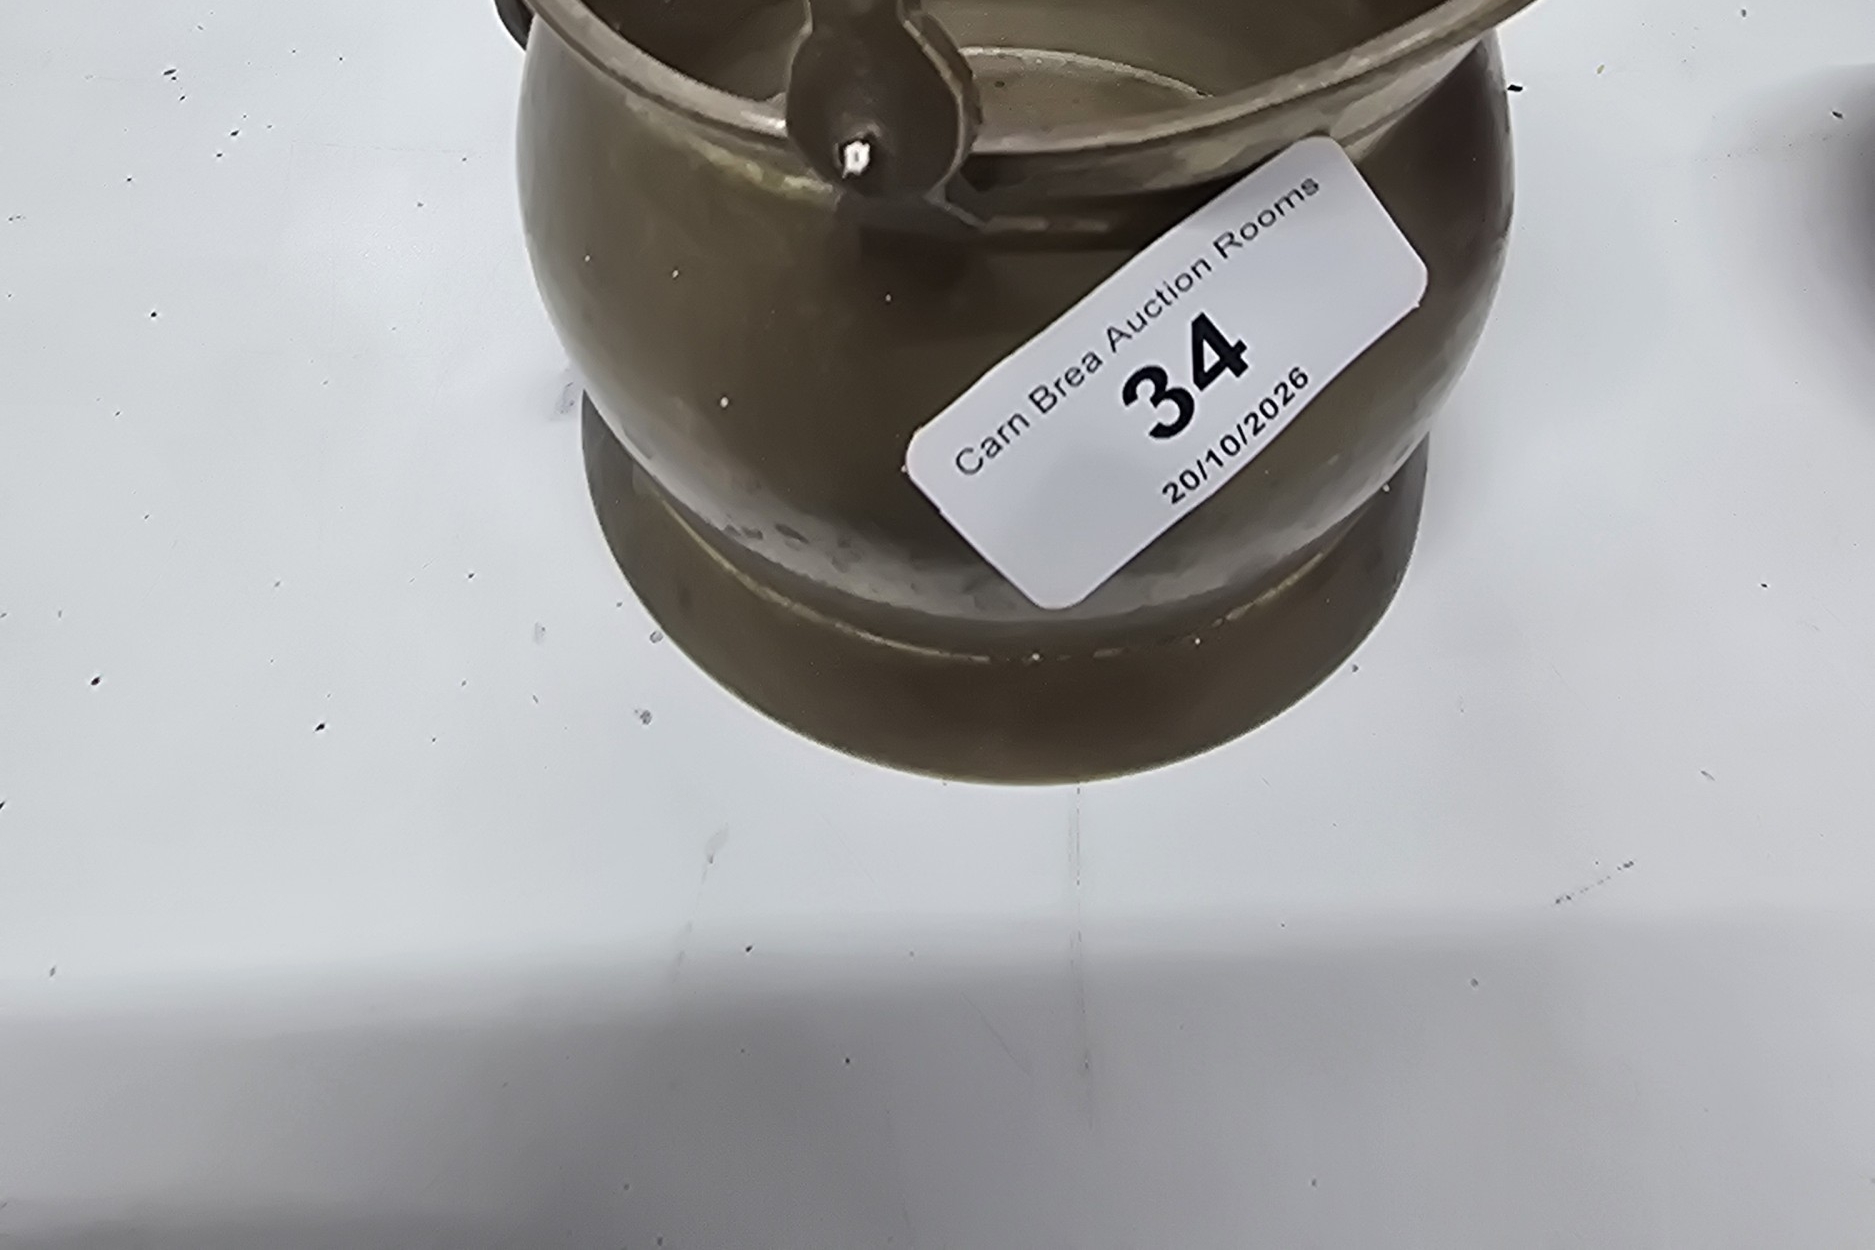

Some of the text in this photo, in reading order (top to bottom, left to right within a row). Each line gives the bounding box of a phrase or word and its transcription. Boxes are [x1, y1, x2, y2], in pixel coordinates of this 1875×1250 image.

[954, 177, 1321, 476] Carn Brea Auction Rooms
[1121, 311, 1250, 440] 34
[1161, 366, 1310, 505] 20/10/2026
